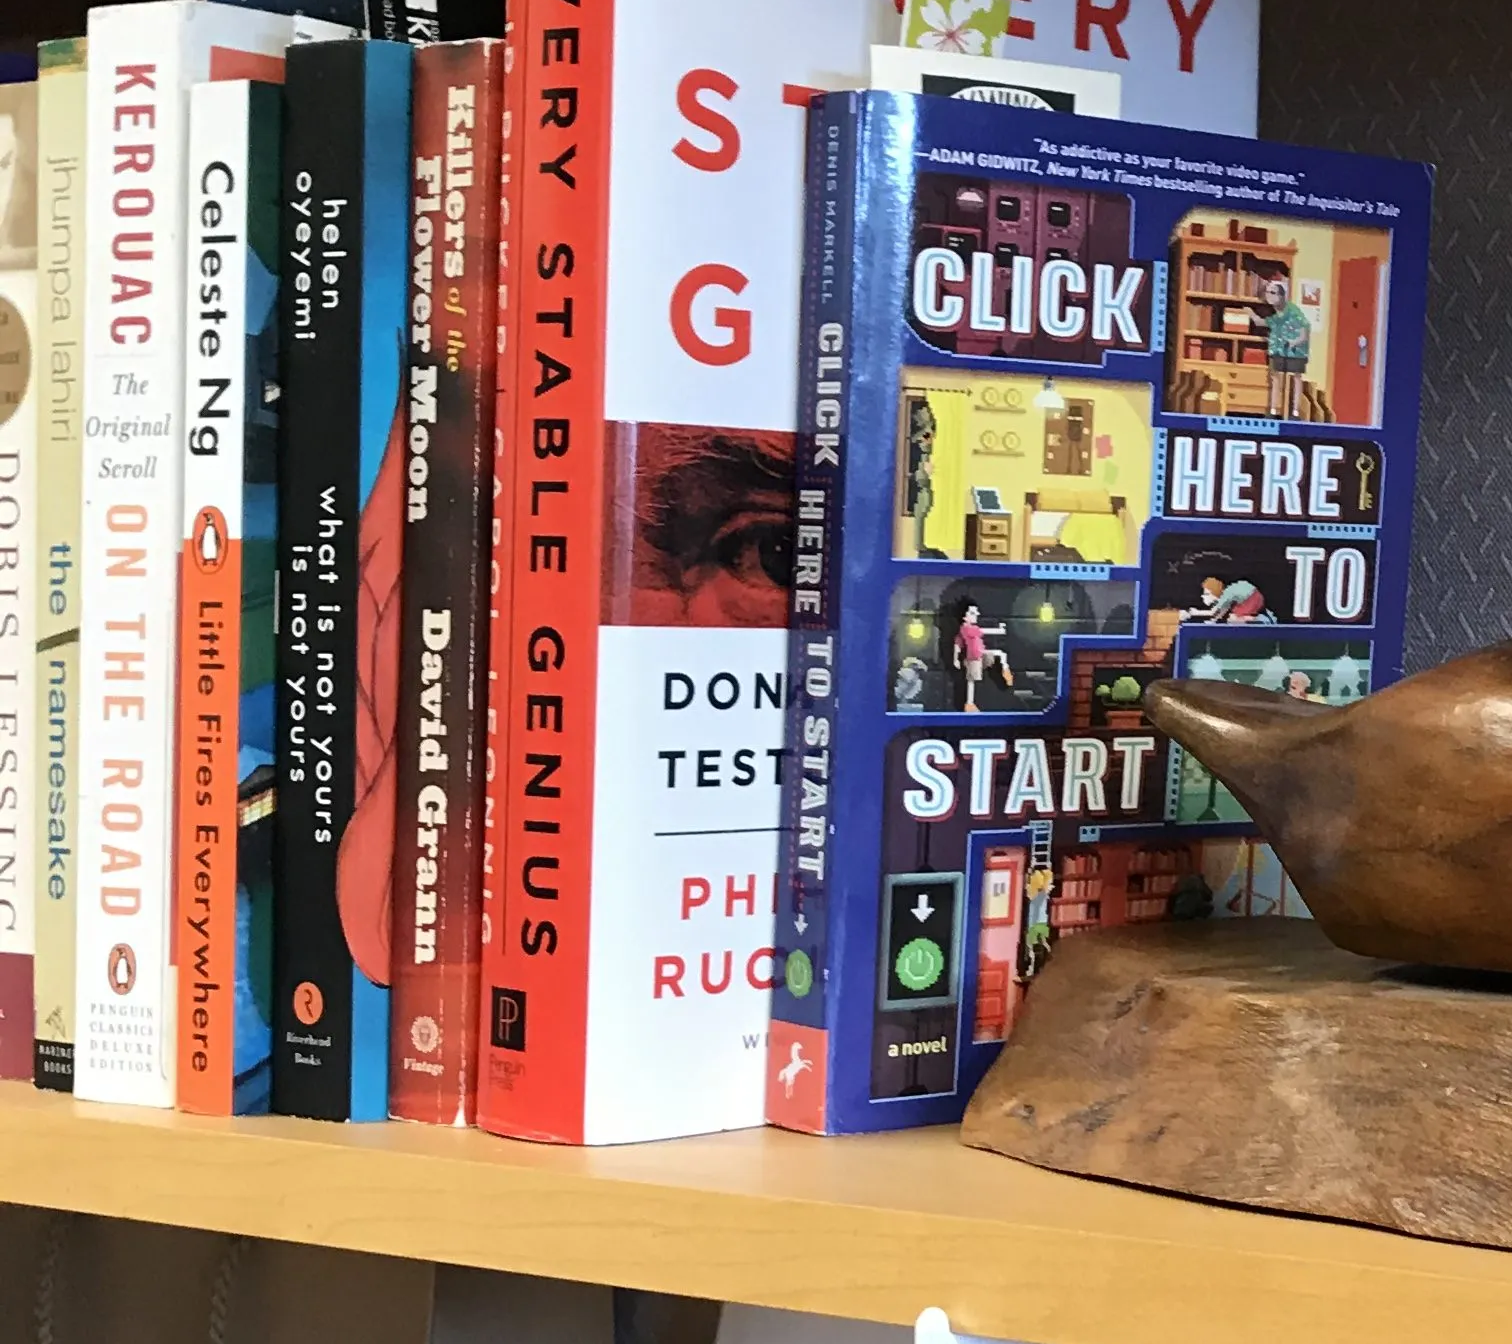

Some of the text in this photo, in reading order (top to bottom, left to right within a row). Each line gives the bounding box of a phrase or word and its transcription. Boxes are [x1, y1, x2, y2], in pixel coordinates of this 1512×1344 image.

[110, 63, 157, 345] KEROUAC
[443, 84, 476, 373] Killers of the
[820, 124, 840, 305] DENIS MARKELL
[976, 154, 1044, 176] GIDWITZ,
[1046, 161, 1080, 178] New
[1080, 164, 1112, 183] York
[1113, 169, 1152, 188] Times
[1153, 173, 1224, 199] bestselling
[1224, 184, 1266, 201] author
[1266, 189, 1281, 203] of
[1283, 189, 1307, 206] The
[1375, 201, 1401, 218] Tale
[1060, 144, 1121, 164] addictive
[1124, 153, 1141, 165] as
[1141, 155, 1173, 170] your
[1174, 157, 1225, 176] favorite
[1226, 163, 1260, 181] video
[47, 156, 79, 442] jhumpa lahiri
[189, 160, 238, 457] Celeste Ng
[290, 170, 317, 340] oyeyemi
[322, 198, 348, 310] helen
[913, 246, 1146, 346] CLICK
[112, 373, 149, 396] The
[407, 155, 442, 524] Flower Moon
[529, 241, 574, 573] STABLE
[85, 413, 172, 443] Original
[98, 456, 158, 480] Scroll
[1170, 436, 1345, 519] HERE
[286, 544, 314, 784] is not yours
[309, 485, 344, 844] what is not yours
[795, 322, 844, 882] CLICK HERE TO START
[1286, 546, 1367, 621] TO
[47, 542, 73, 902] the namesake
[99, 503, 148, 918] ON THE ROAD
[414, 608, 452, 965] David Grann
[520, 624, 567, 957] GENIUS
[902, 736, 1156, 820] START
[187, 600, 226, 1073] Little Fires Everywhere
[89, 1020, 154, 1037] CLASSICS
[89, 1038, 153, 1056] DELUXE
[89, 1057, 153, 1074] EDITION
[90, 1002, 153, 1019] PENGUIN
[888, 1035, 947, 1057] a novel
